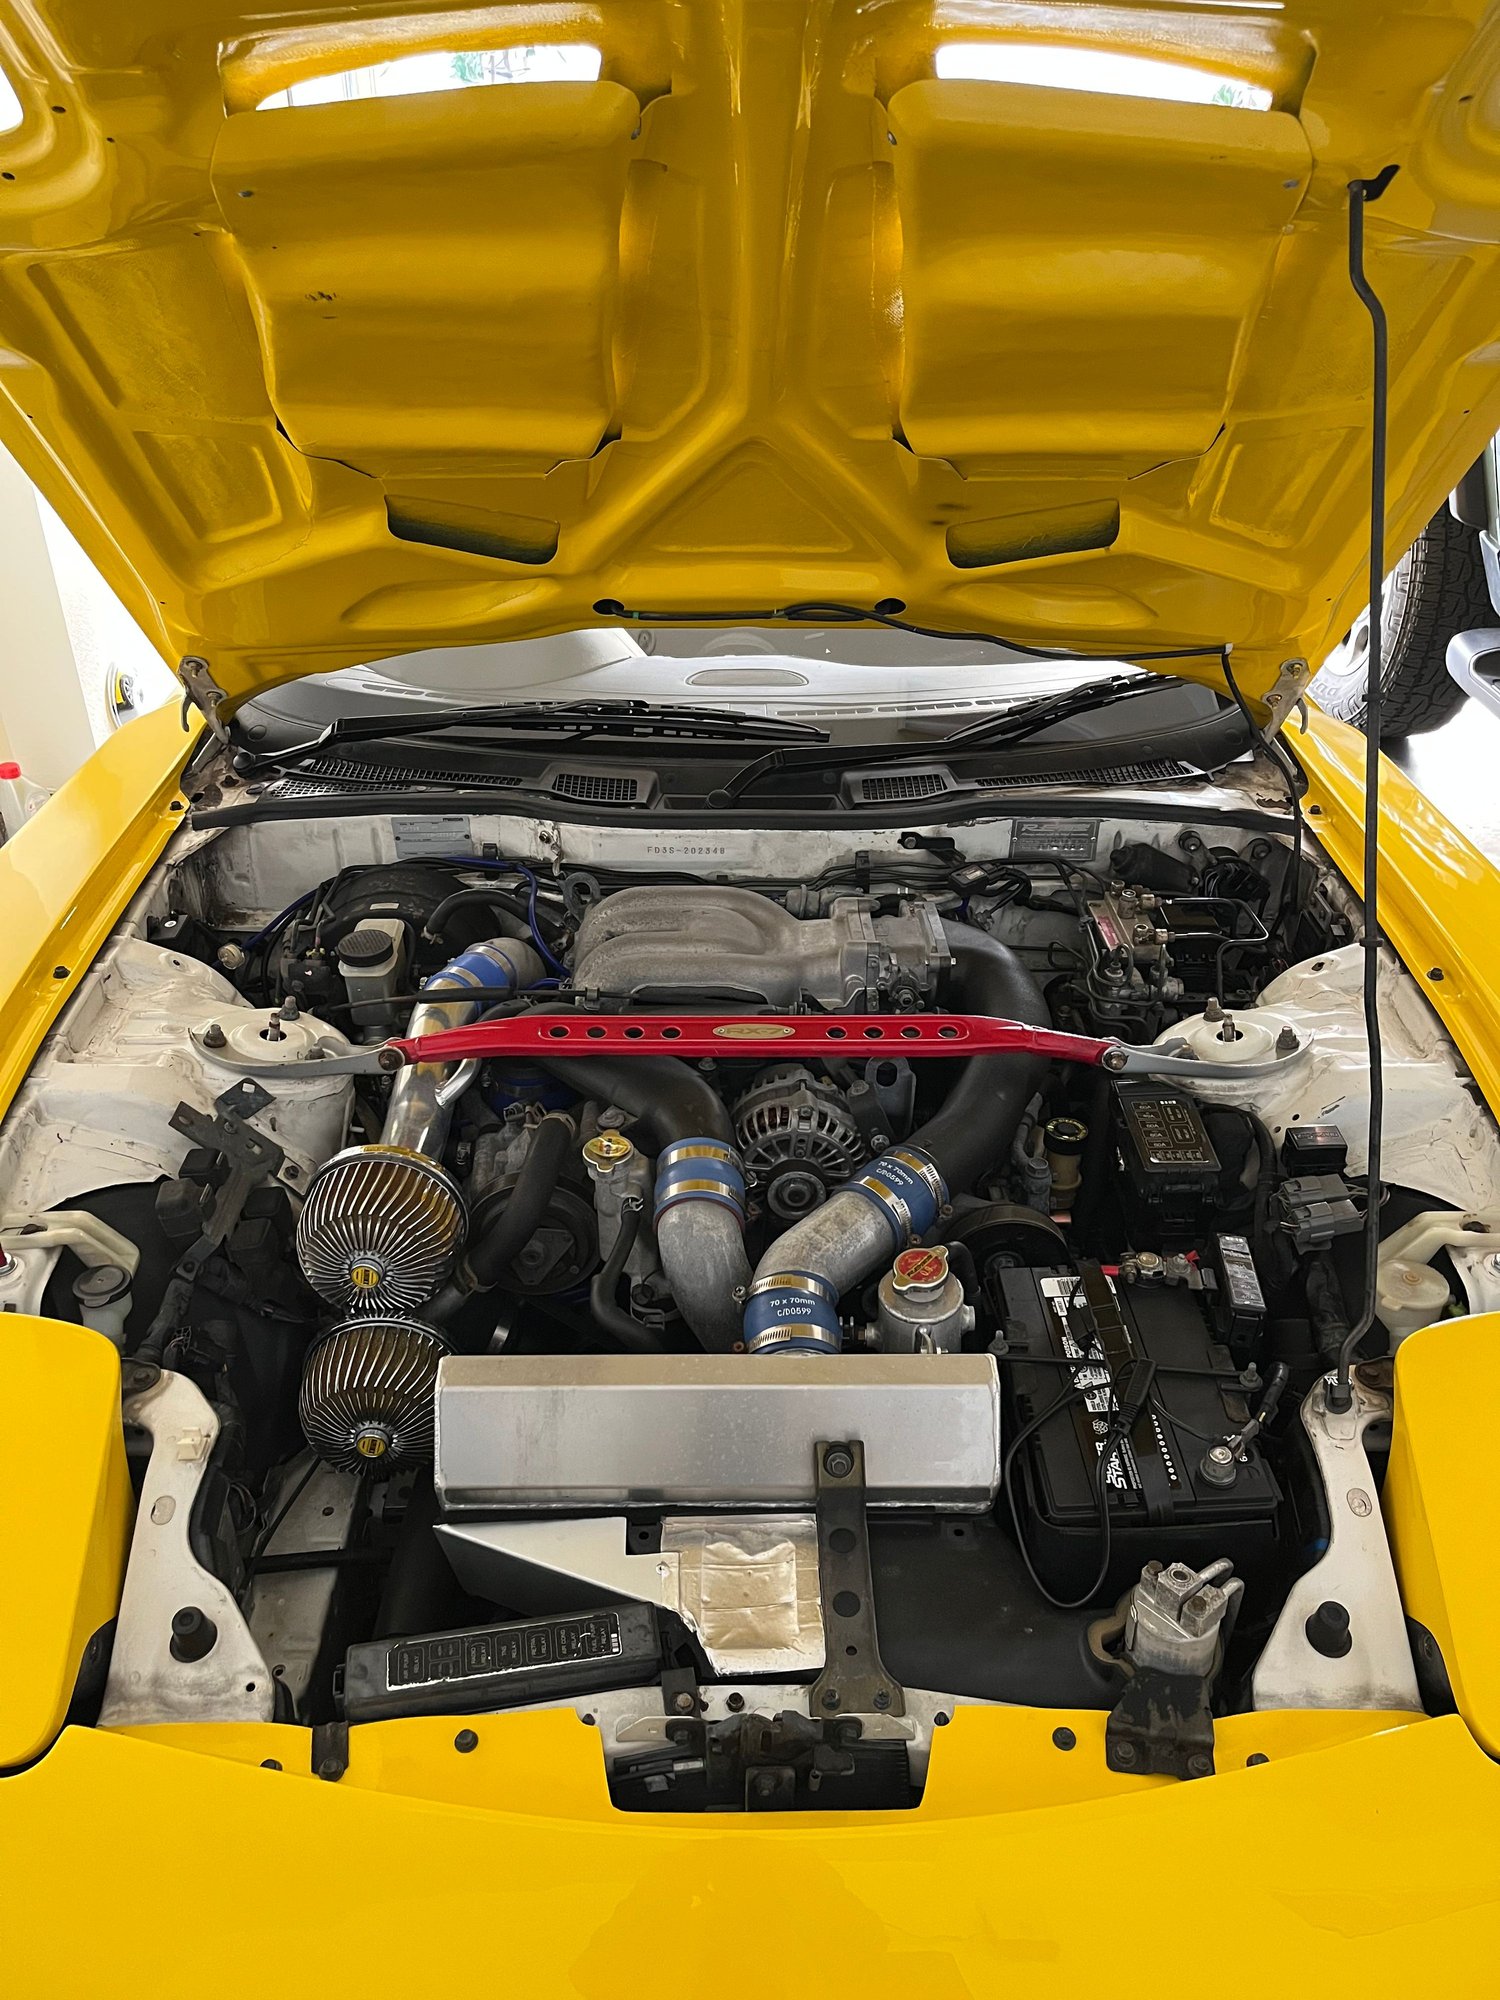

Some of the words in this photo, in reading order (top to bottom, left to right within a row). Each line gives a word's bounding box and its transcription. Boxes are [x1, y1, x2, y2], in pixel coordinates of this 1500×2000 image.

[646, 845, 726, 856] FD3S-202348
[726, 1027, 783, 1036] RX-7
[893, 1166, 914, 1185] 70mm
[769, 1299, 781, 1308] 70
[789, 1297, 816, 1306] 70mm
[776, 1306, 812, 1317] C/D0599
[1060, 1335, 1073, 1359] POISON
